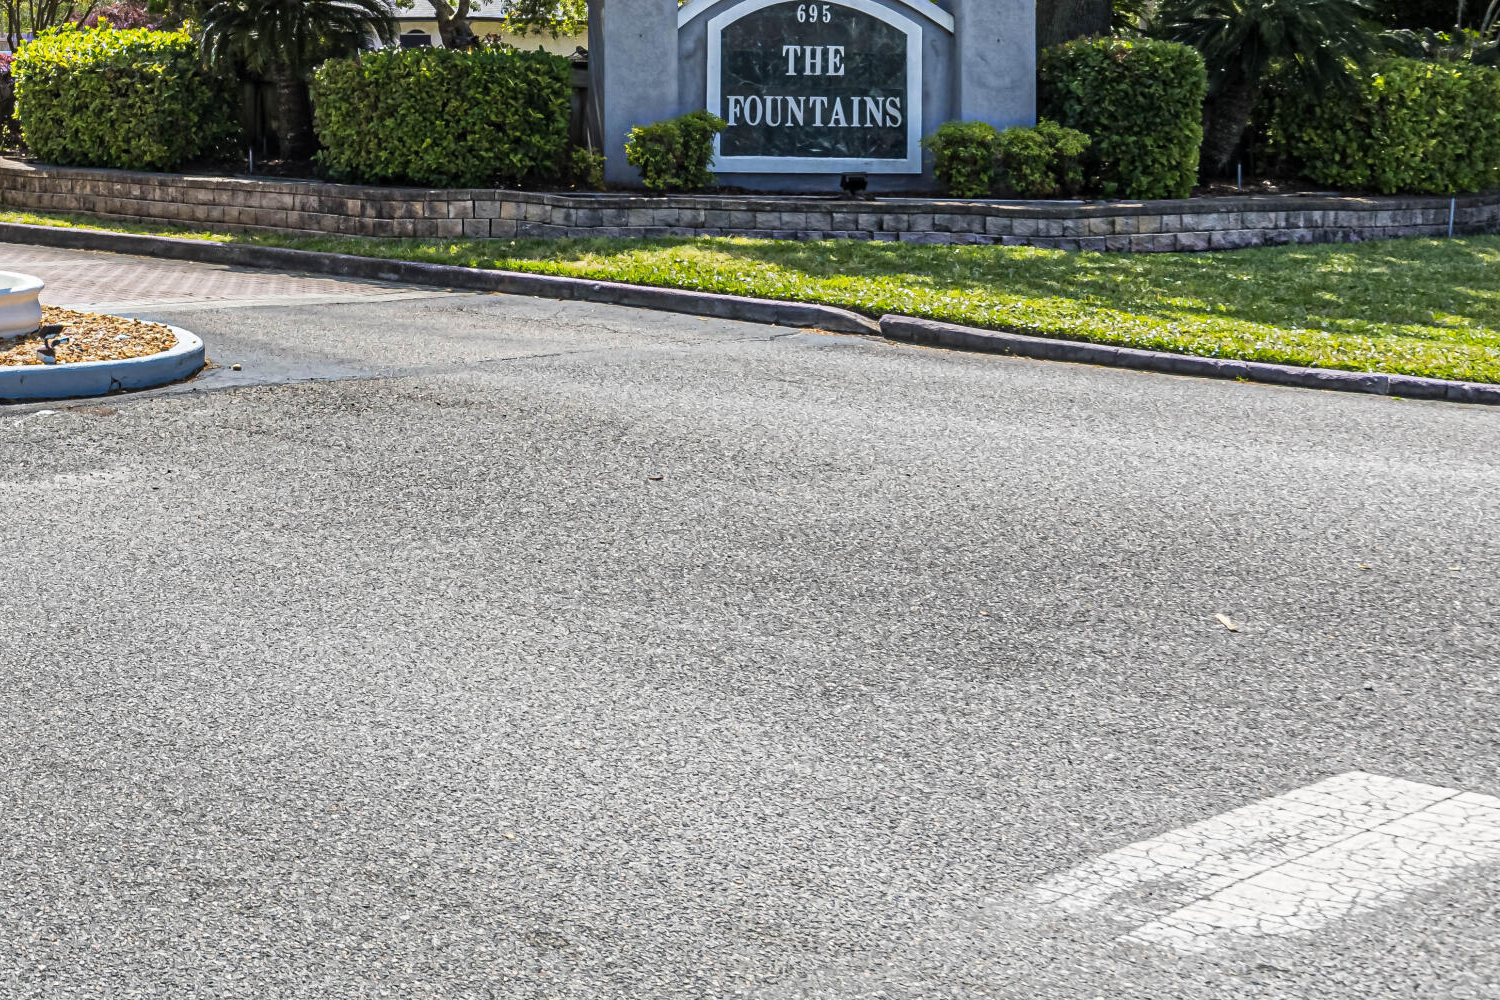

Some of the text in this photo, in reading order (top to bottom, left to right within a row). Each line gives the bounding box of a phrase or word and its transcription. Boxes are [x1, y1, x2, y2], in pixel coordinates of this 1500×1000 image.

[797, 4, 831, 23] 695
[782, 45, 845, 76] THE
[727, 95, 902, 128] FOUNTAINS
